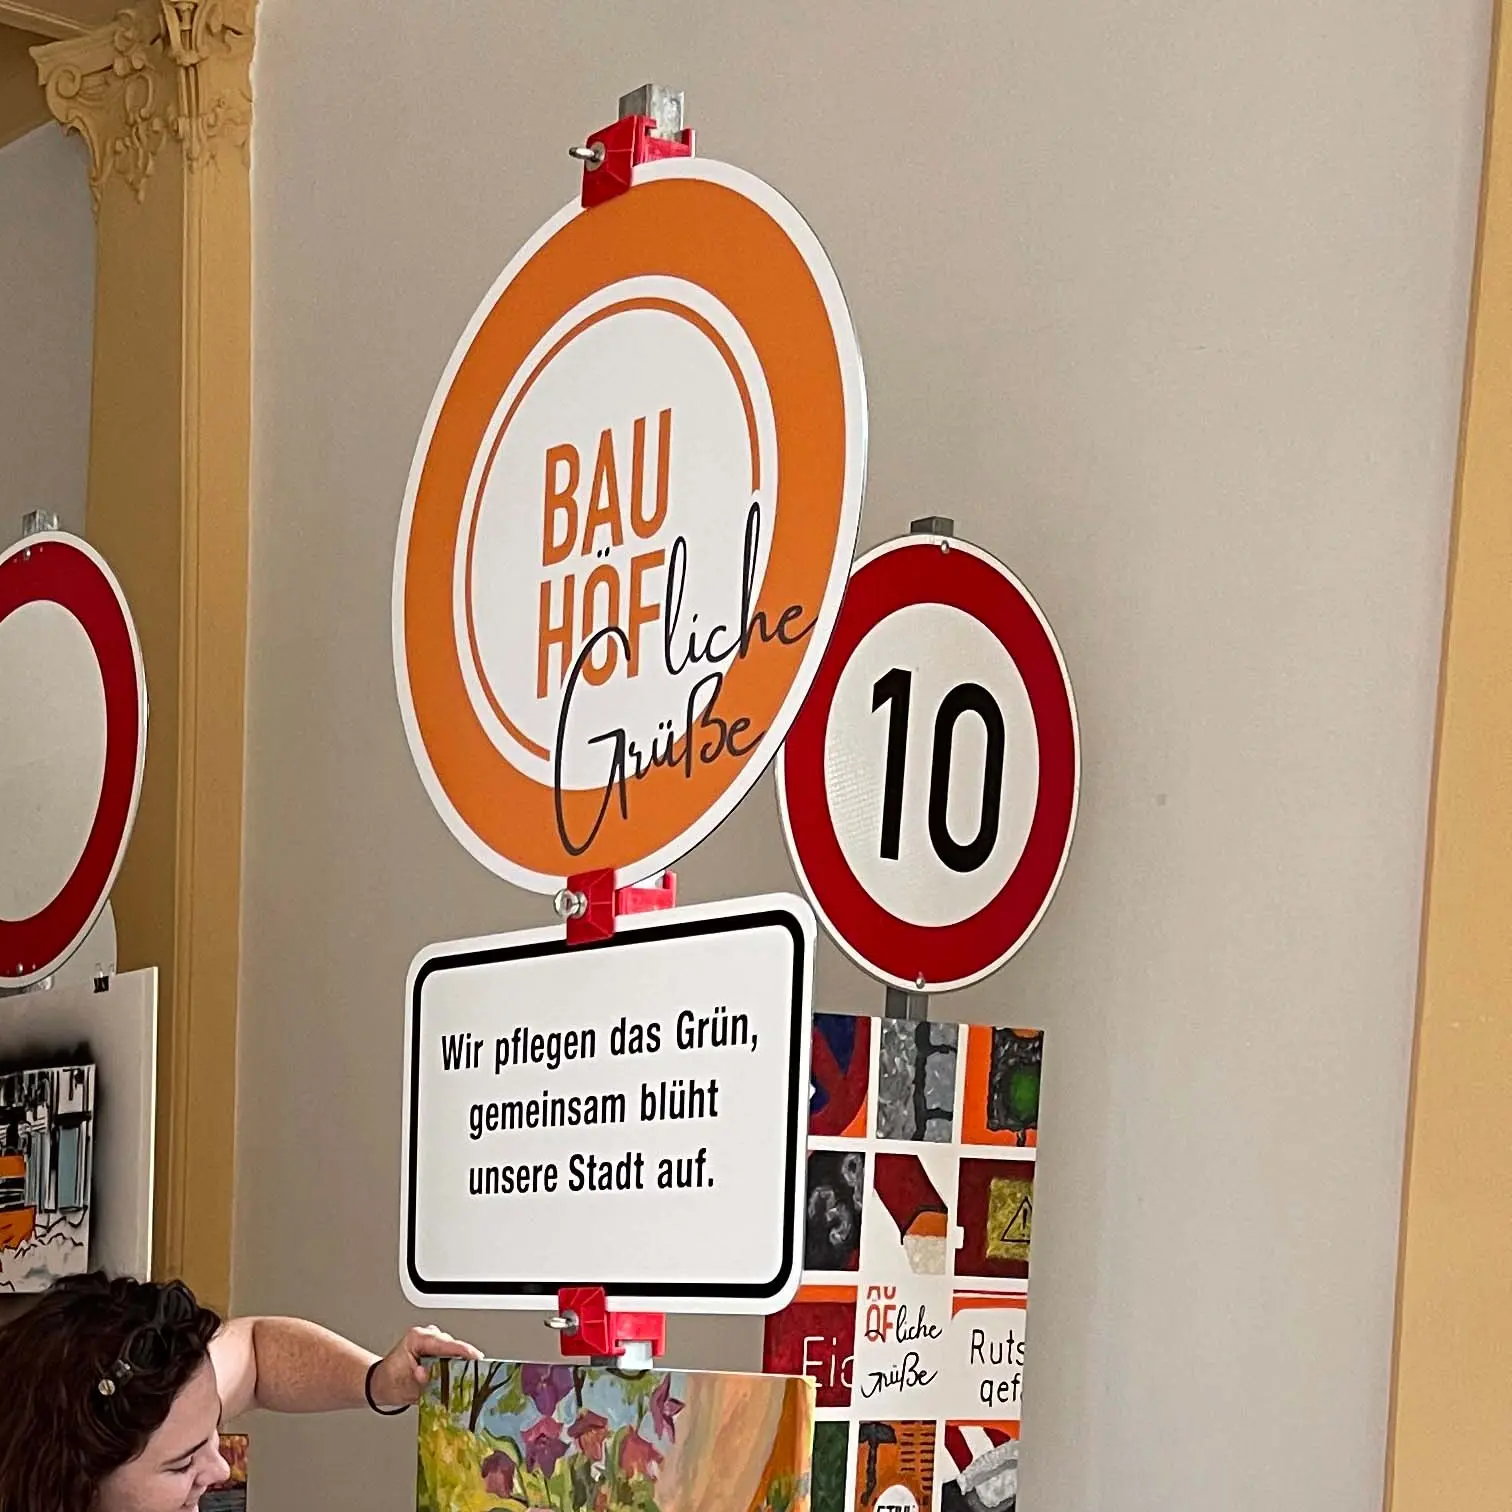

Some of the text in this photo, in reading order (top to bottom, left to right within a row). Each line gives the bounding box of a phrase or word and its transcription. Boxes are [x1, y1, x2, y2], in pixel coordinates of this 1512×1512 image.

[541, 408, 672, 567] BAU
[554, 624, 765, 856] Grüße
[872, 668, 1005, 873] 10
[441, 1006, 759, 1074] Wir pflegen das Grün,
[469, 1079, 718, 1140] gemeinsam blüht
[469, 1147, 714, 1195] unsere Stadt auf.
